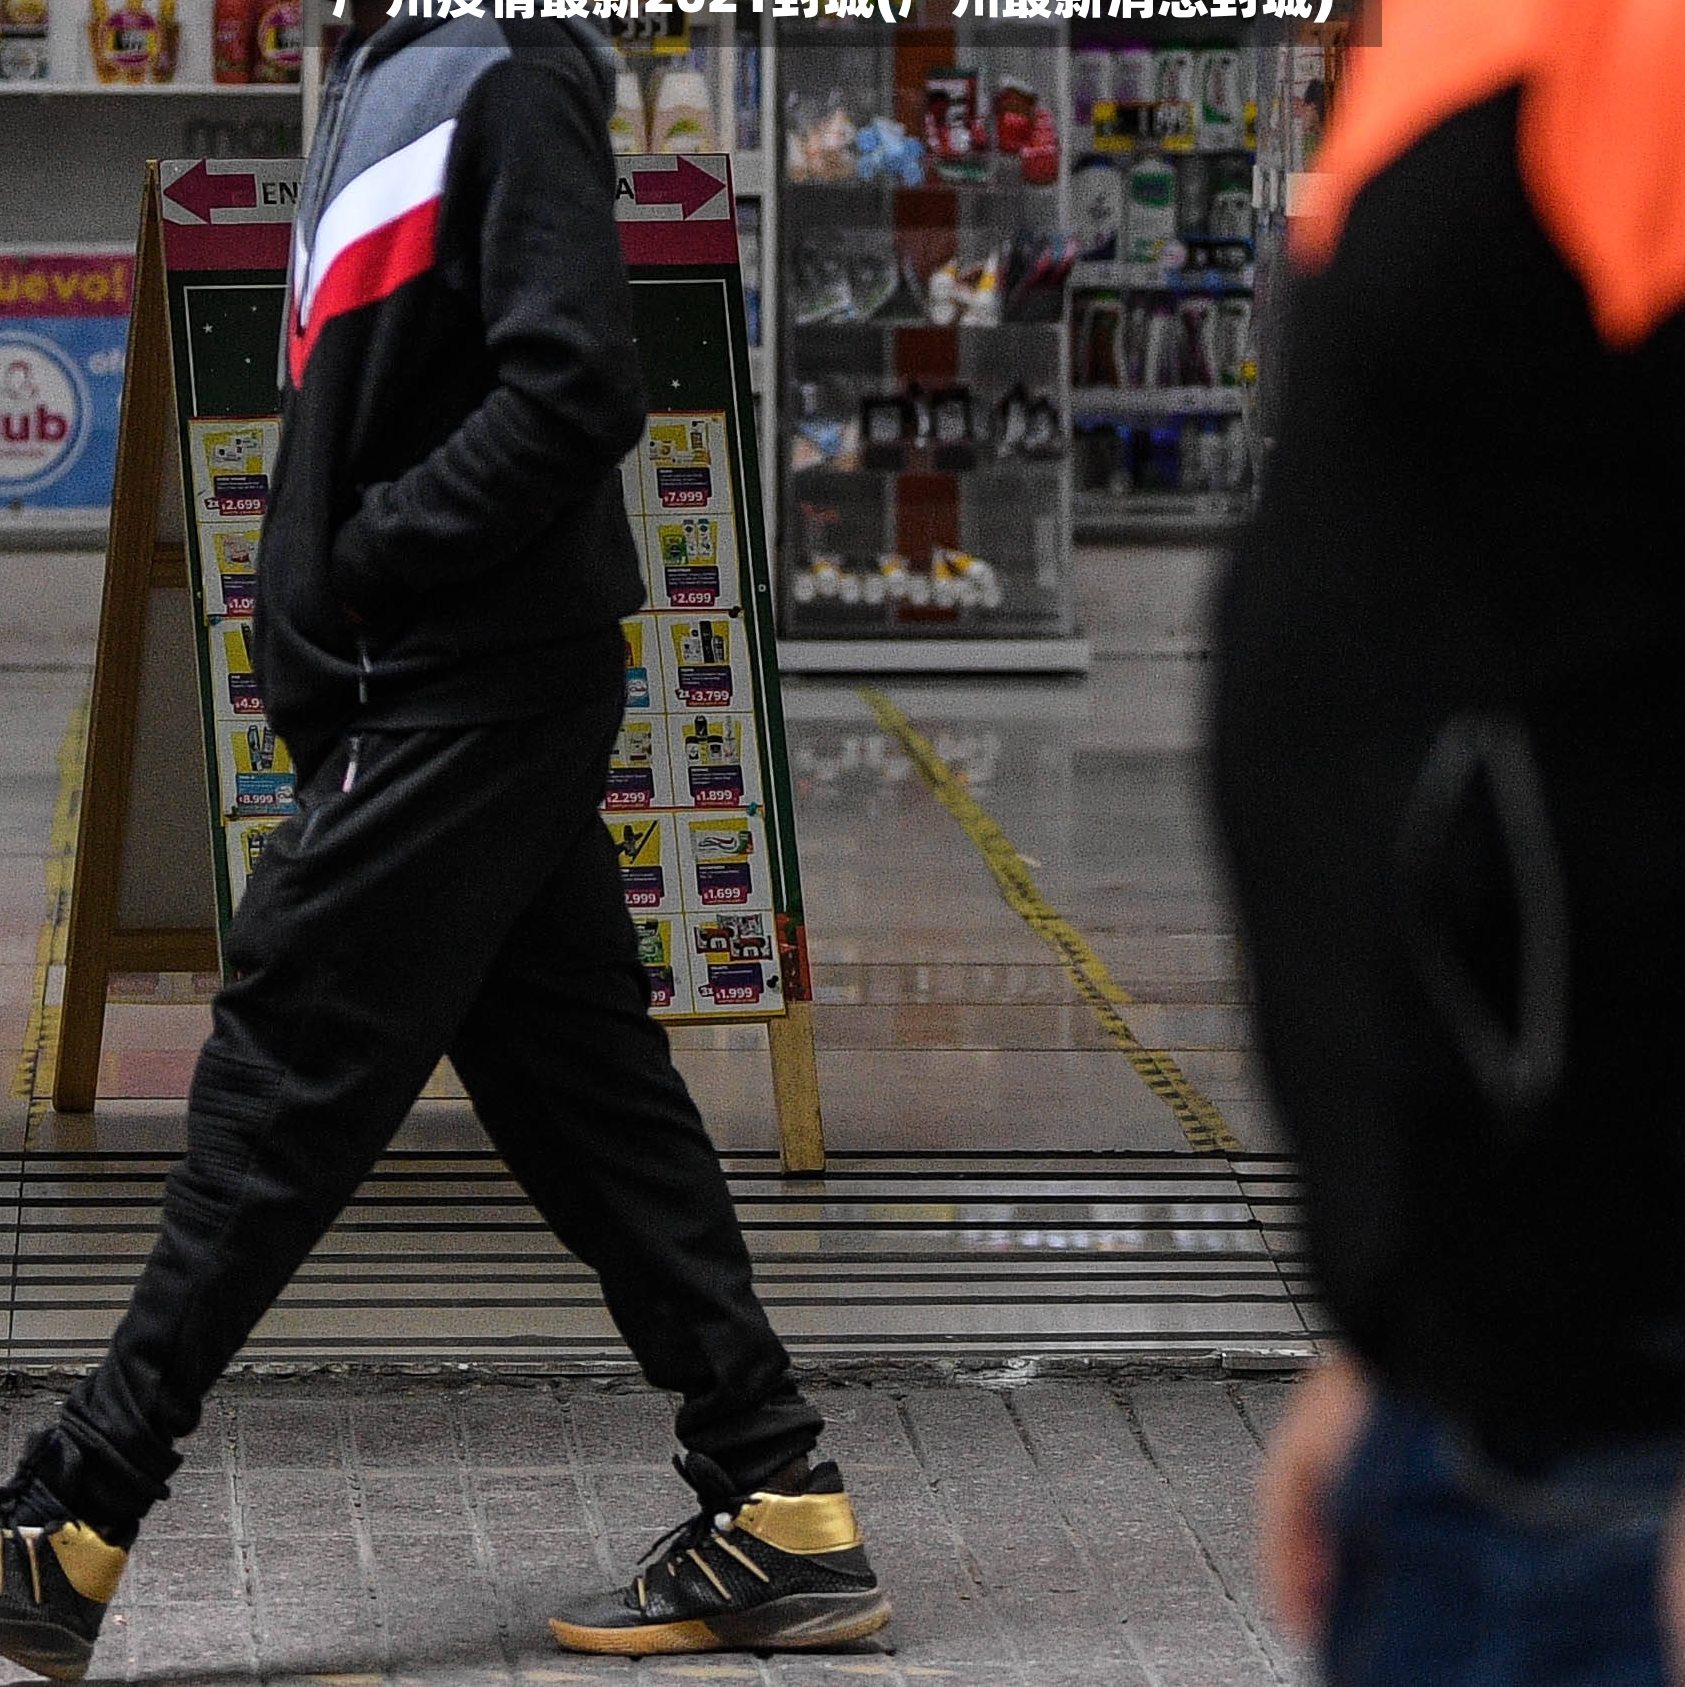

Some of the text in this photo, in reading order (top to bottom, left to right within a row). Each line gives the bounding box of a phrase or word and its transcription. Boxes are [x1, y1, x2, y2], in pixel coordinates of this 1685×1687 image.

[664, 491, 703, 502] $7.999
[672, 593, 711, 603] $2.699
[703, 888, 741, 899] $1.699
